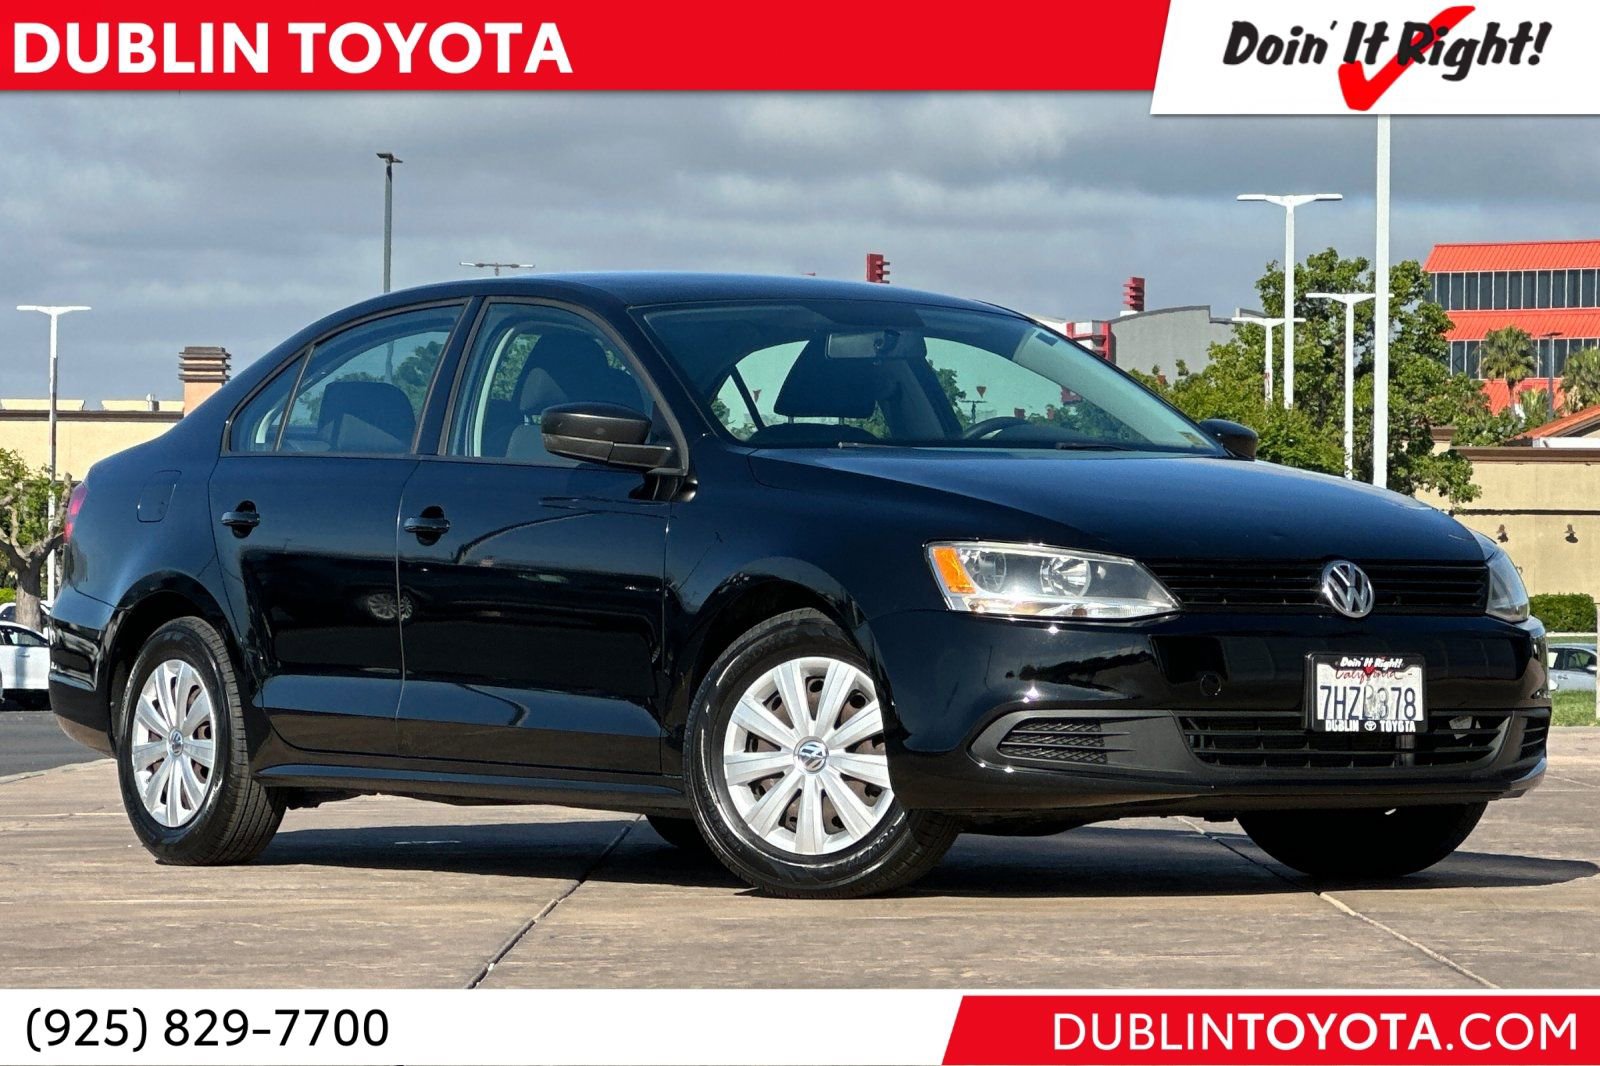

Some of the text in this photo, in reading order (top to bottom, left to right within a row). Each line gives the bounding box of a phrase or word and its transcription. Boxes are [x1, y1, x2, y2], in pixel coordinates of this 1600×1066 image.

[1340, 656, 1404, 671] Doin' It Right!
[1335, 668, 1404, 684] Califrnia
[1325, 719, 1416, 733] DUBLIN TOYOTA
